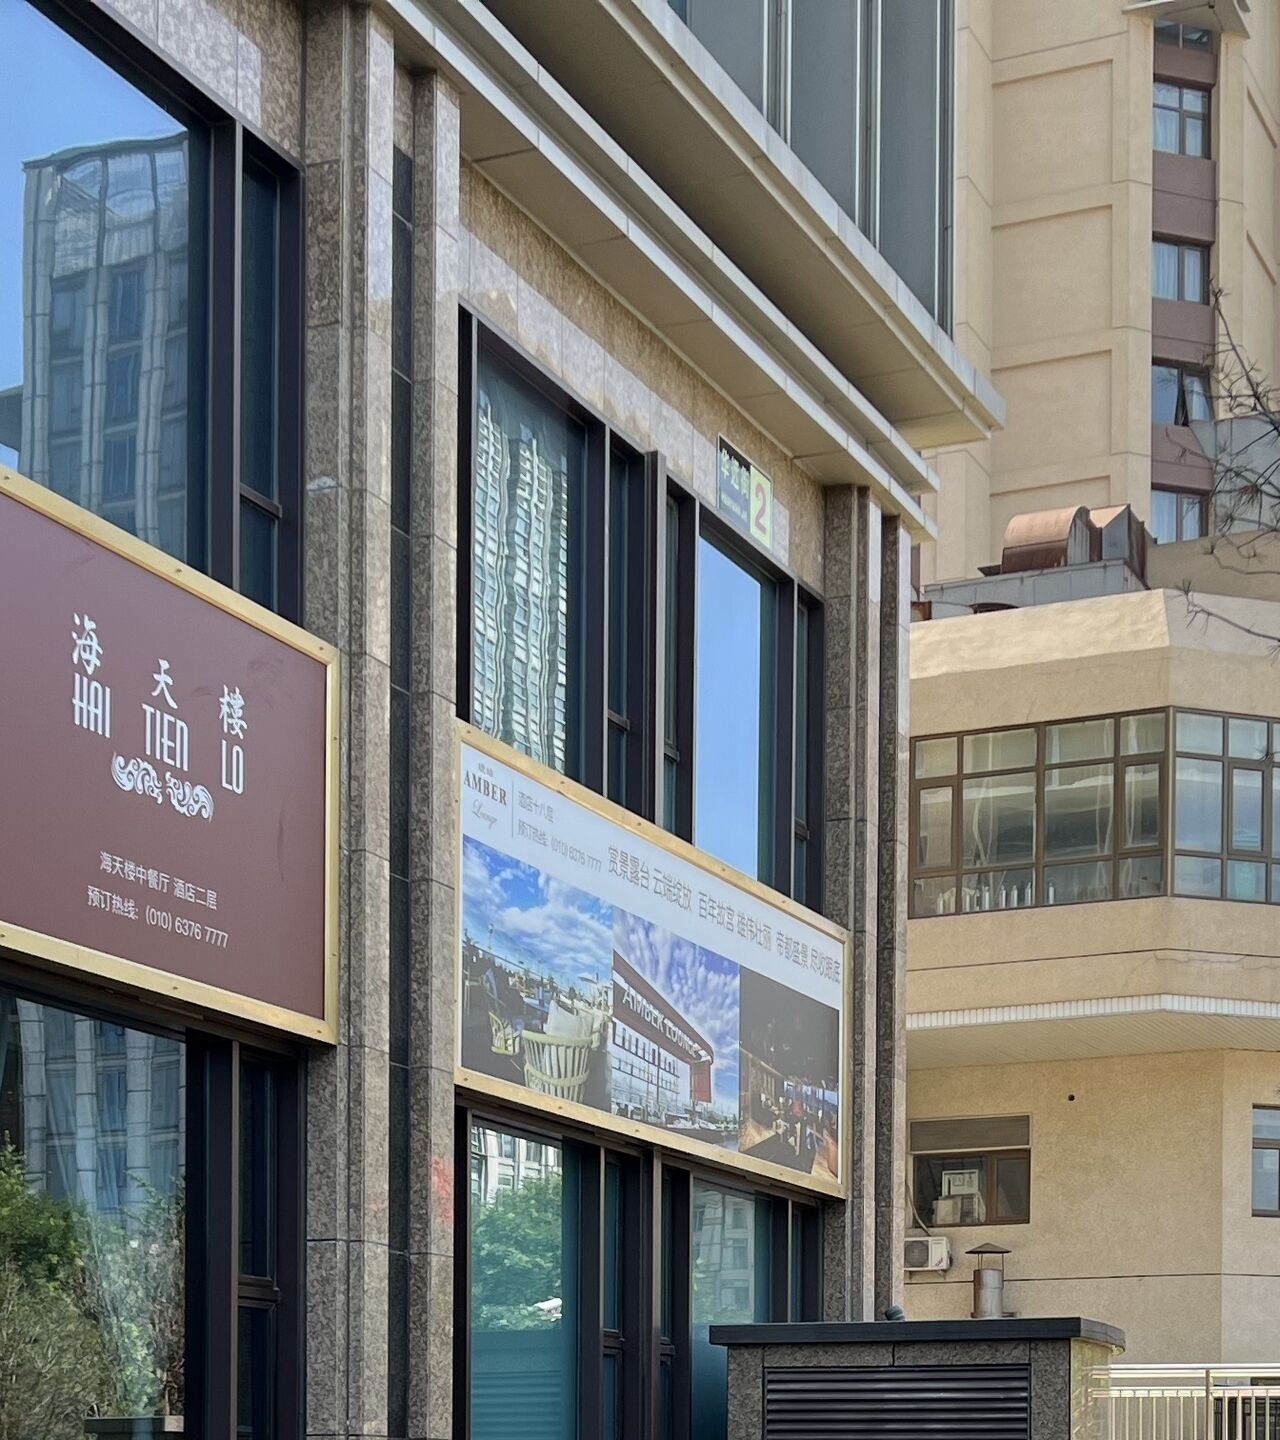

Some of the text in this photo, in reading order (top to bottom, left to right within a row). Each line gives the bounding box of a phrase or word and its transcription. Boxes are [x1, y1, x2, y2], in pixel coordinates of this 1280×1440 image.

[754, 482, 767, 536] 2
[72, 672, 245, 795] HAI TIEN LO
[463, 770, 507, 806] AMBER
[99, 850, 218, 910] 海天楼中餐厅 酒店二层
[145, 904, 173, 932] (010)
[174, 916, 202, 940] 6376
[204, 926, 228, 948] 7777
[698, 890, 735, 933] 百年故宫
